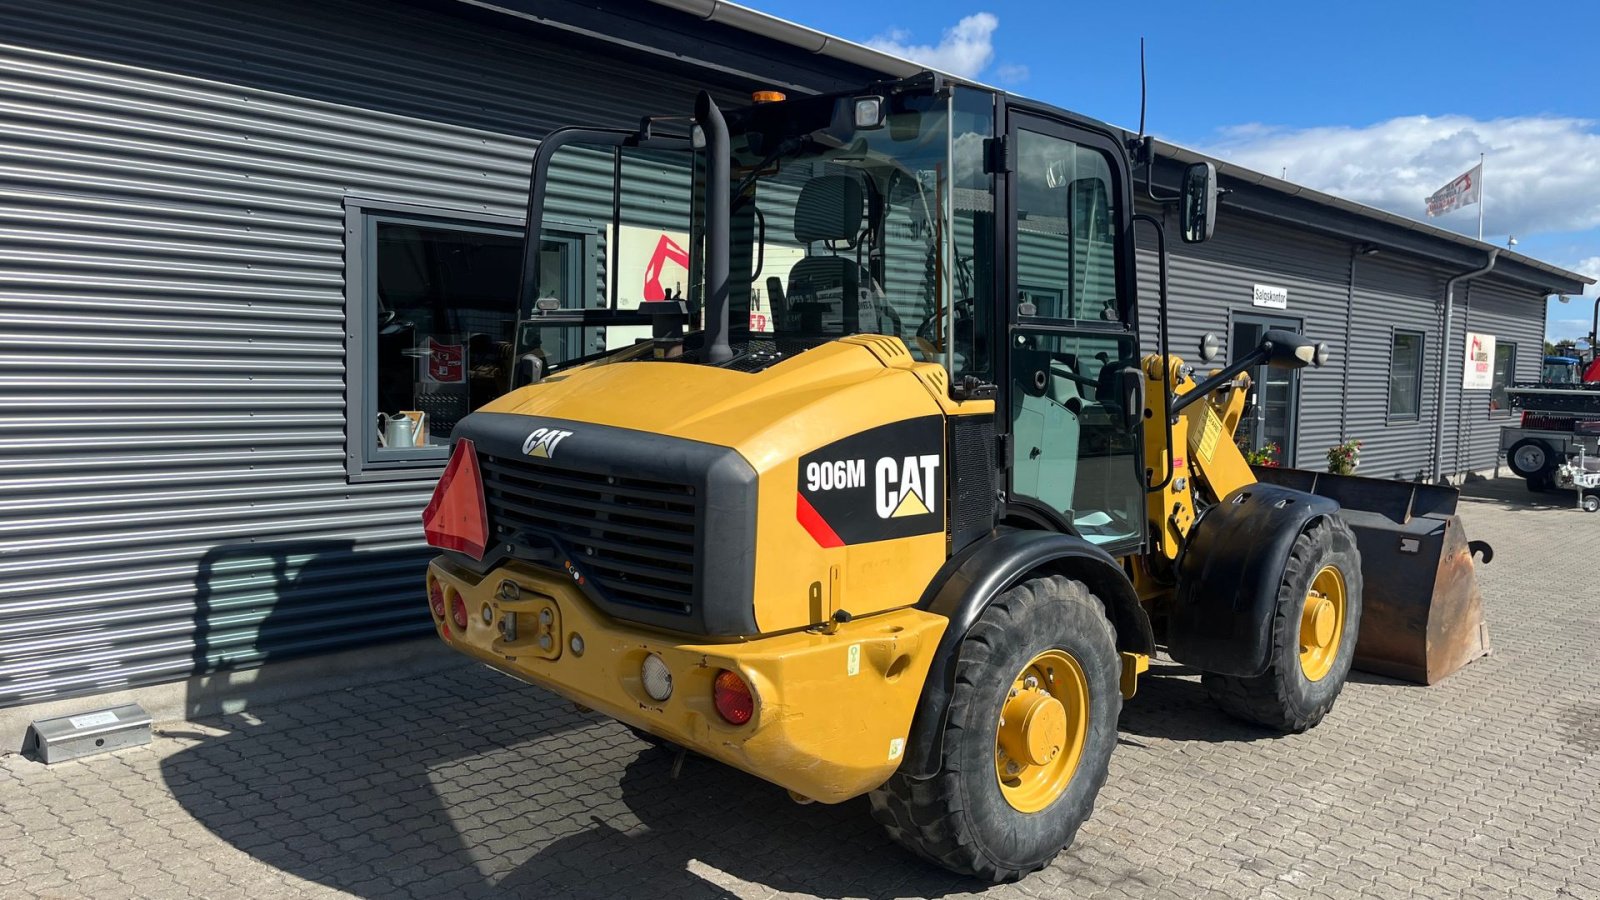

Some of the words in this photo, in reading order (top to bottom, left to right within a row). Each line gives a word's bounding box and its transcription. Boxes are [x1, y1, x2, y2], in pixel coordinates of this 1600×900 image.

[1255, 288, 1286, 303] Salgskontor
[522, 427, 574, 459] CAT
[806, 459, 866, 492] 906M
[875, 454, 940, 519] CAT
